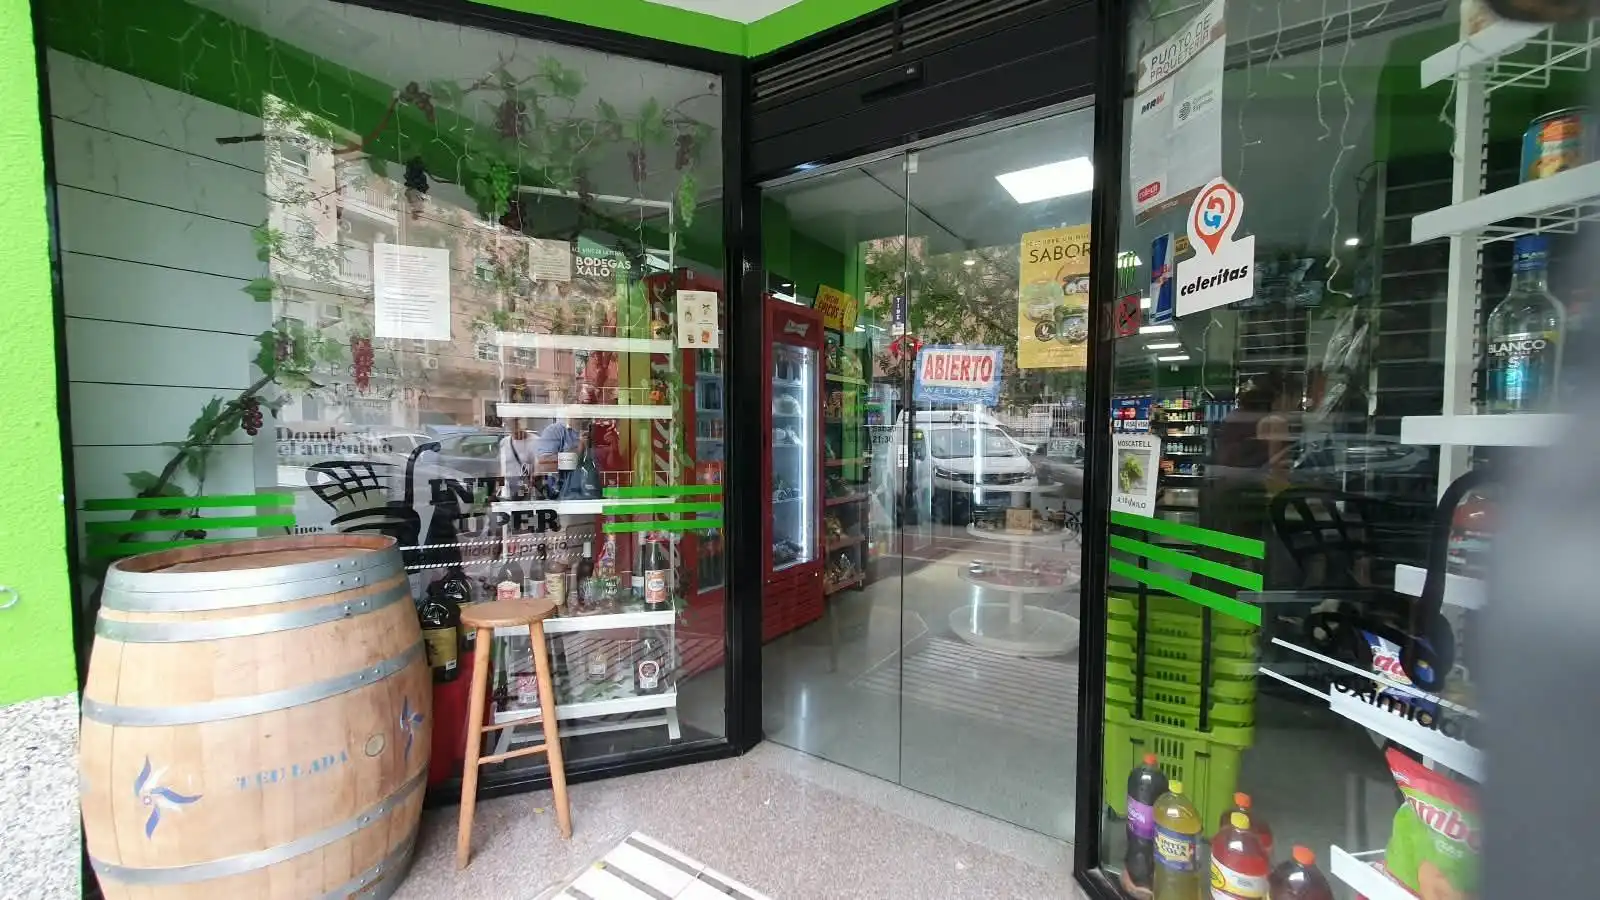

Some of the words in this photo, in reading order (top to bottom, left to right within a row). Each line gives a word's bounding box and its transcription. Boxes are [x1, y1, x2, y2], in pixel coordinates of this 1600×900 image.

[1141, 92, 1166, 114] MRW
[575, 256, 632, 270] BODEGAS
[1028, 242, 1091, 264] SABOR
[1180, 265, 1249, 297] celeritas
[1488, 339, 1546, 353] BLANCO
[922, 353, 993, 383] ABIERTO
[1117, 440, 1153, 448] MOSCATELL
[456, 509, 562, 535] UPER
